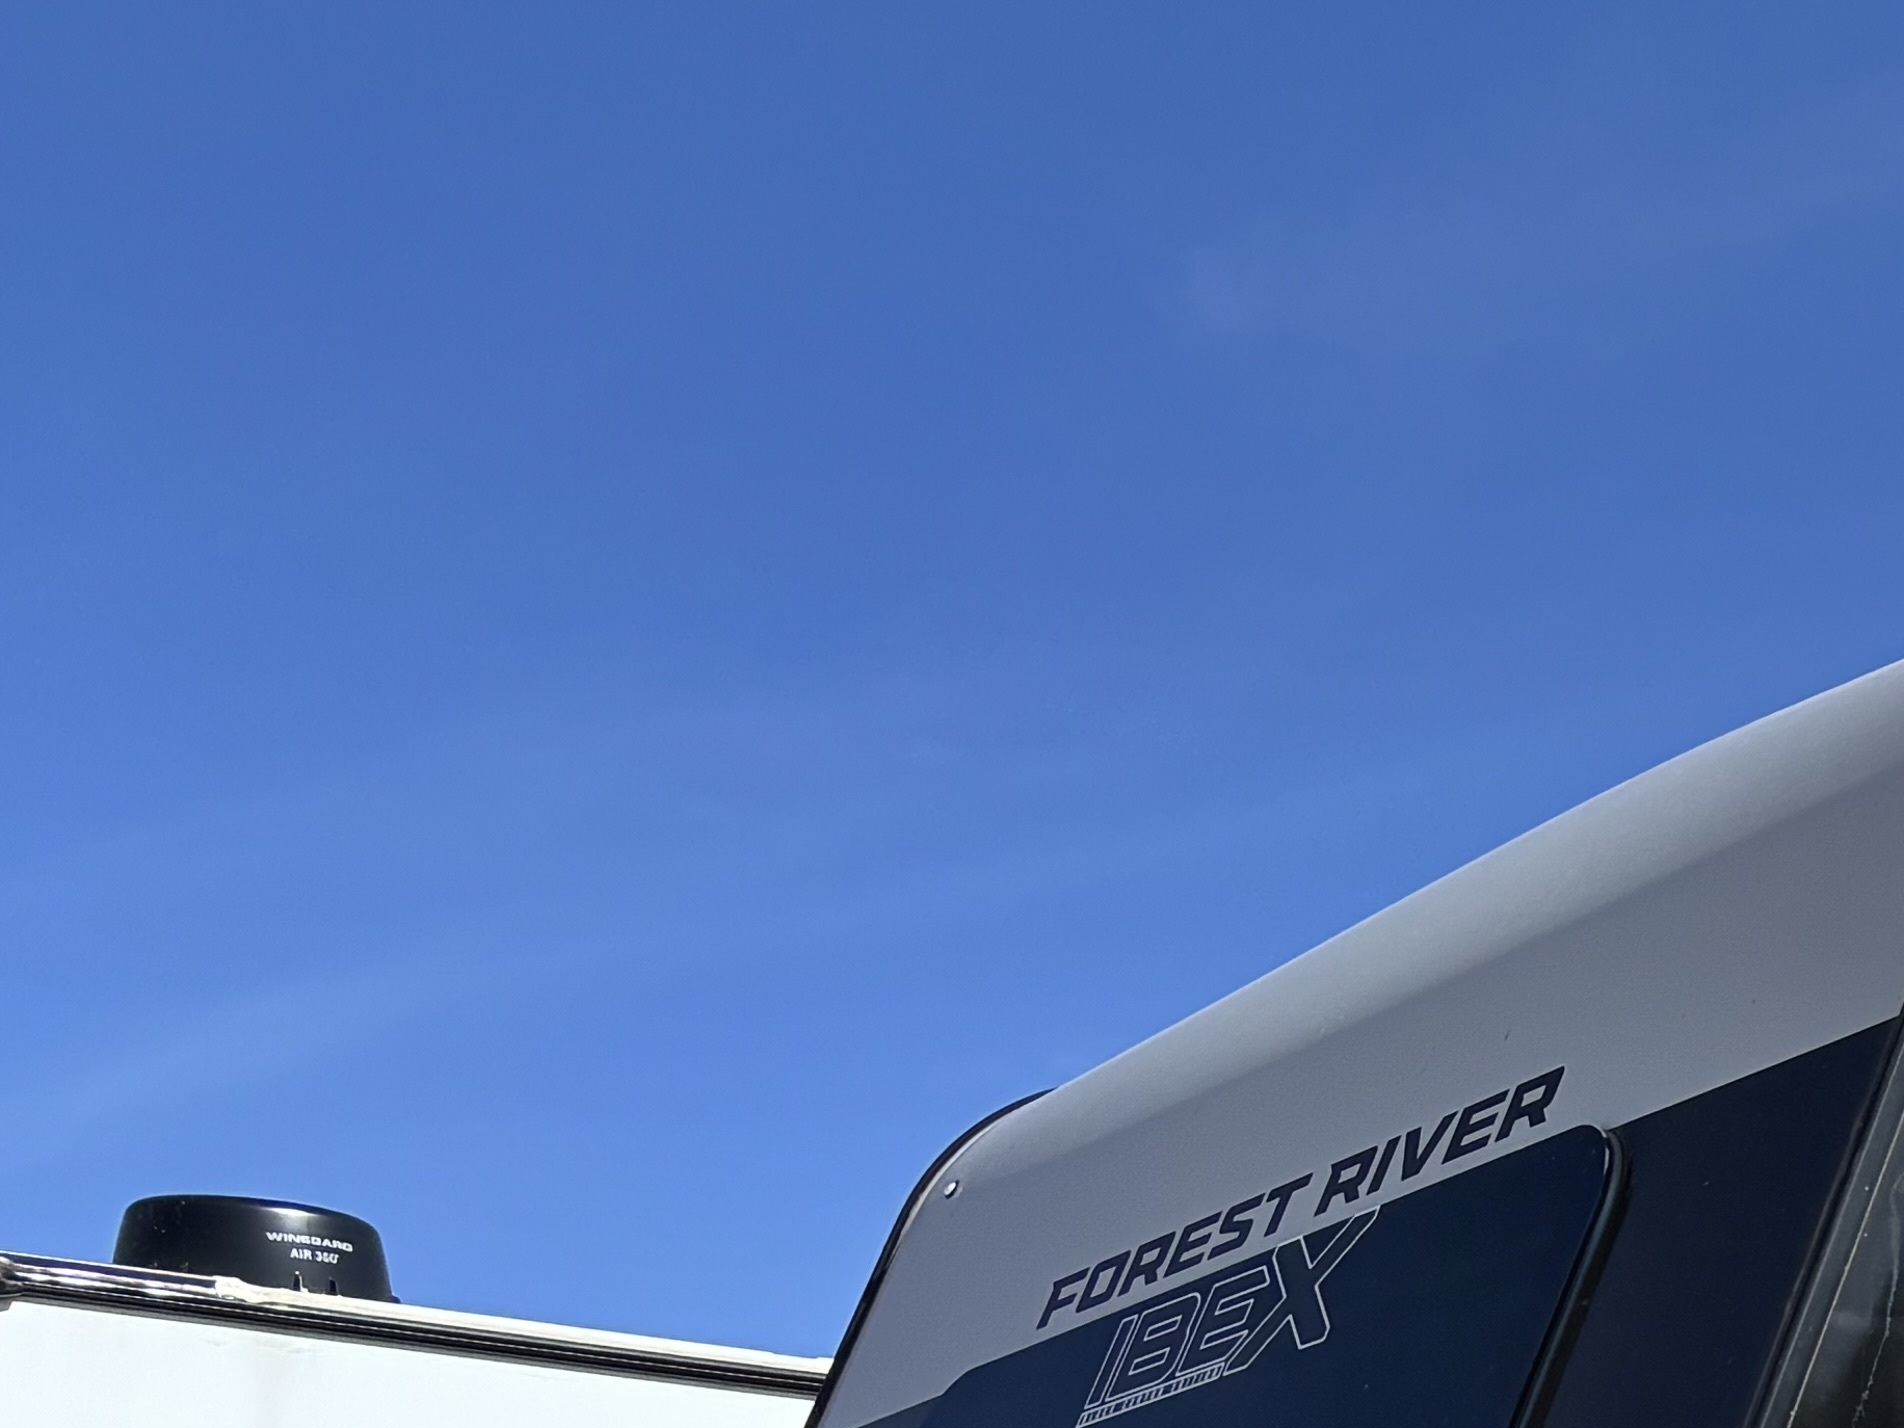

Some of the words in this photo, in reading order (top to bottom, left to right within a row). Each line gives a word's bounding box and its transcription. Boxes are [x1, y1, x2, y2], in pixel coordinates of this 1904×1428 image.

[290, 1247, 313, 1261] AIR
[1036, 1172, 1314, 1330] FOREST
[1313, 1066, 1566, 1217] RIVER
[1084, 1205, 1380, 1410] IBEX
